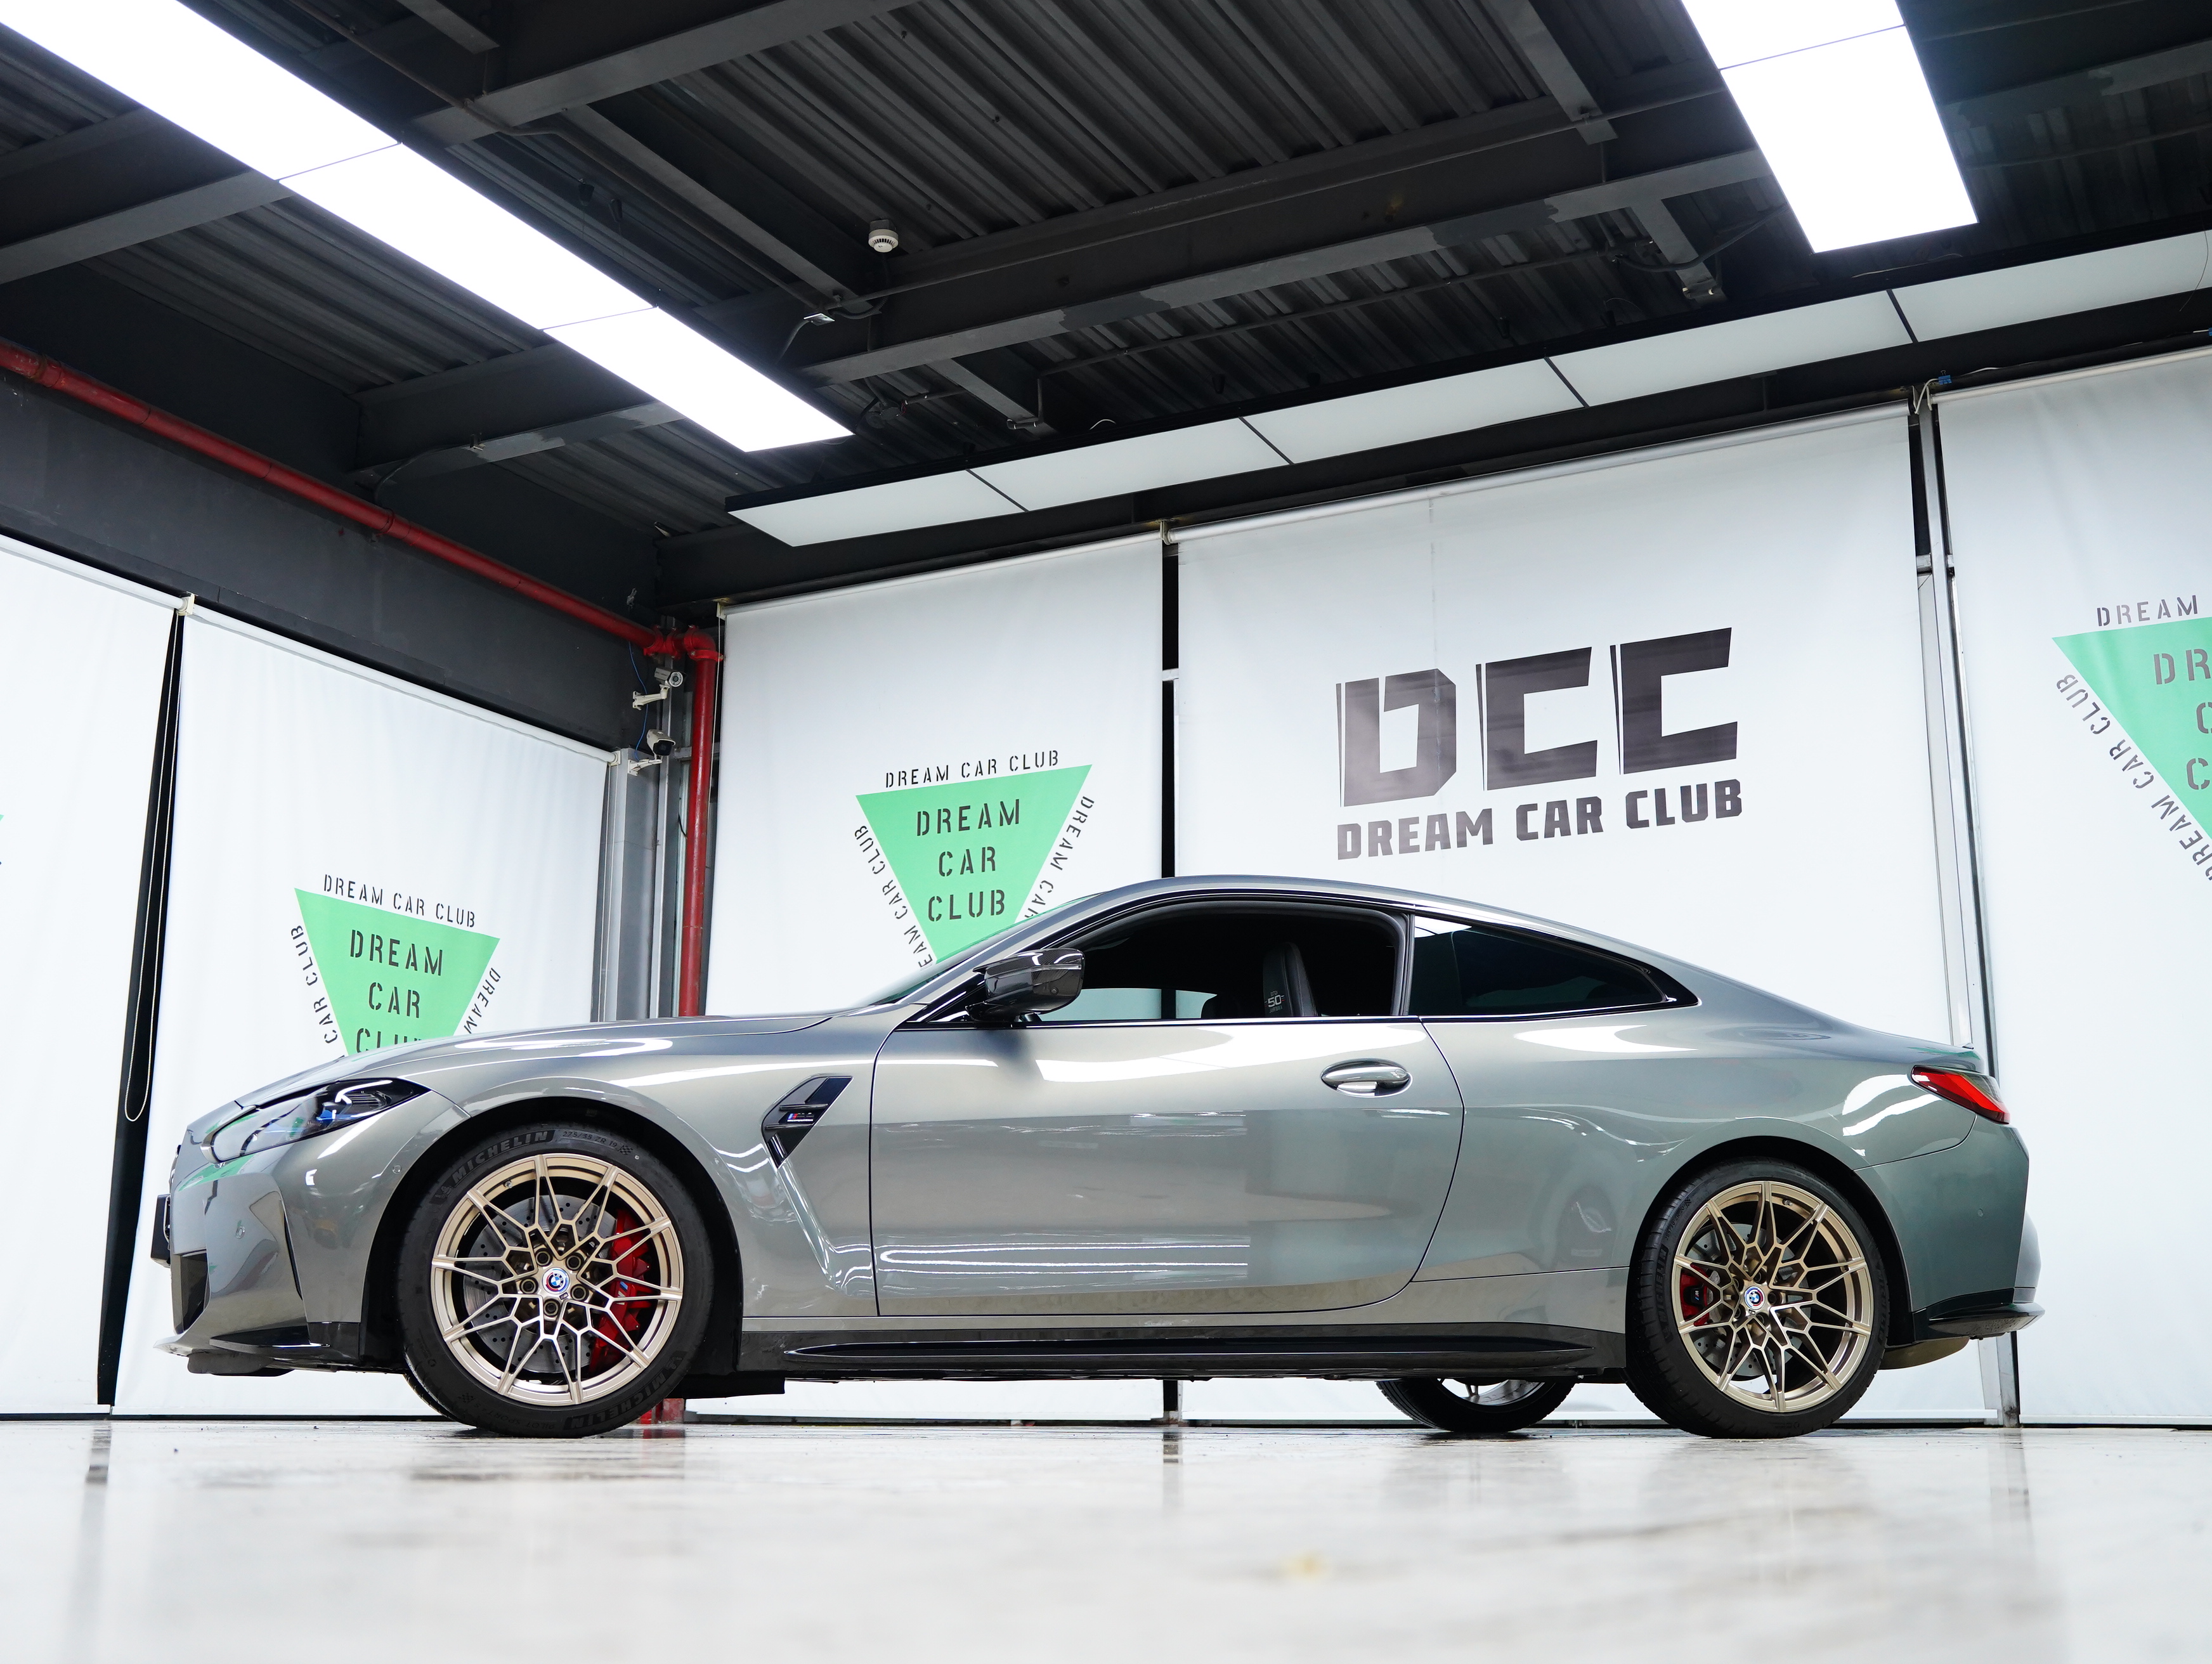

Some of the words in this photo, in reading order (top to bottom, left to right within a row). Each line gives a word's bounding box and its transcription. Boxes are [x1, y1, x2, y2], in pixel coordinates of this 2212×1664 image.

[2097, 595, 2198, 627] DREAM
[1336, 627, 1738, 807] DCC
[2056, 674, 2111, 736] CLUB
[886, 764, 949, 788] DREAM
[961, 758, 997, 779] CAR
[1009, 750, 1059, 772] CLUB
[2109, 739, 2154, 789] CAR
[916, 799, 1020, 836] DREAM
[1050, 796, 1095, 871] DREAM
[1337, 808, 1493, 860] DREAM
[1516, 796, 1604, 841] CAR
[1625, 779, 1742, 829] CLUB
[854, 825, 885, 874] CLUB
[939, 847, 996, 876] CAR
[323, 874, 383, 906] DREAM
[393, 892, 425, 916] CAR
[436, 902, 476, 928] CLUB
[882, 880, 908, 920] CAR
[928, 889, 1005, 922] CLUB
[290, 925, 318, 986] CLUB
[350, 929, 443, 977] DREAM
[904, 925, 933, 968] EAM
[313, 996, 338, 1044] CAR
[368, 982, 420, 1018] CAR
[464, 967, 501, 1034] DREAM
[1268, 994, 1282, 1008] 50
[452, 1131, 548, 1184] MICHELIN
[562, 1131, 593, 1140] 275/35
[1655, 1246, 1669, 1324] MICHELIN
[571, 1371, 666, 1429] MICHELIN
